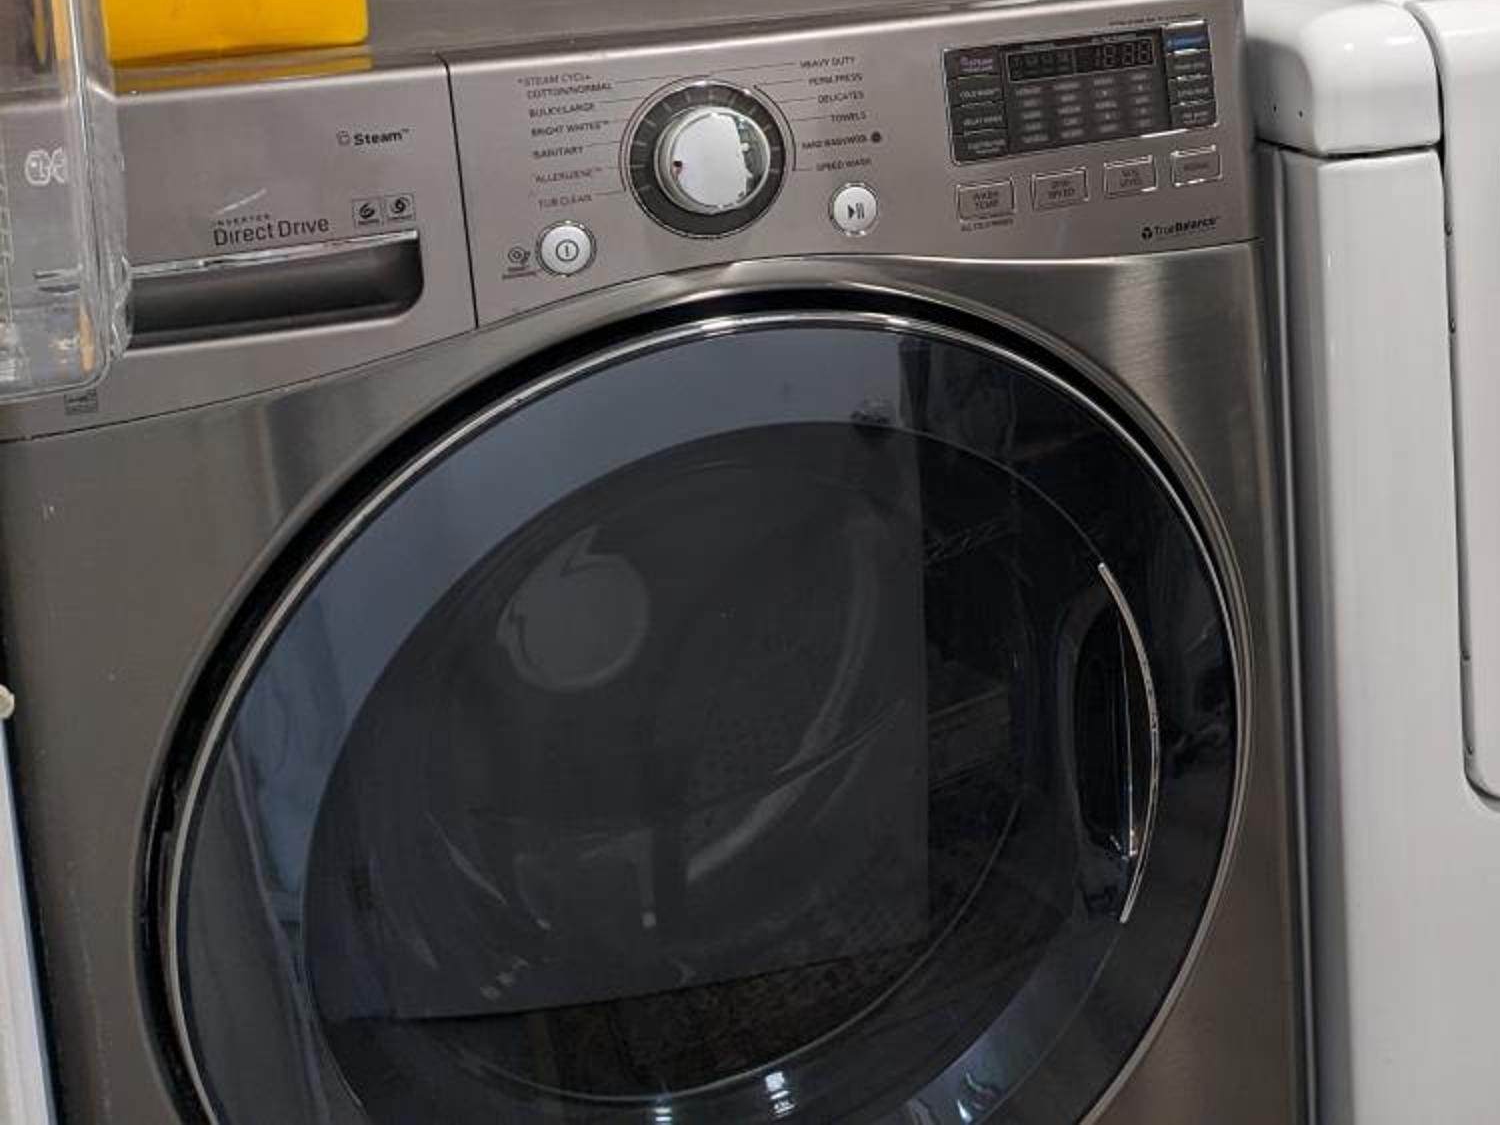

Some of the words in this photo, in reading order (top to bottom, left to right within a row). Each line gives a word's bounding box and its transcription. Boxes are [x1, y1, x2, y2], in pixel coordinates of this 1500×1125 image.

[831, 55, 856, 67] DUTY
[817, 90, 865, 104] DELICATES
[831, 110, 867, 123] TOWELS
[213, 224, 274, 246] Direct
[277, 217, 330, 239] Drive
